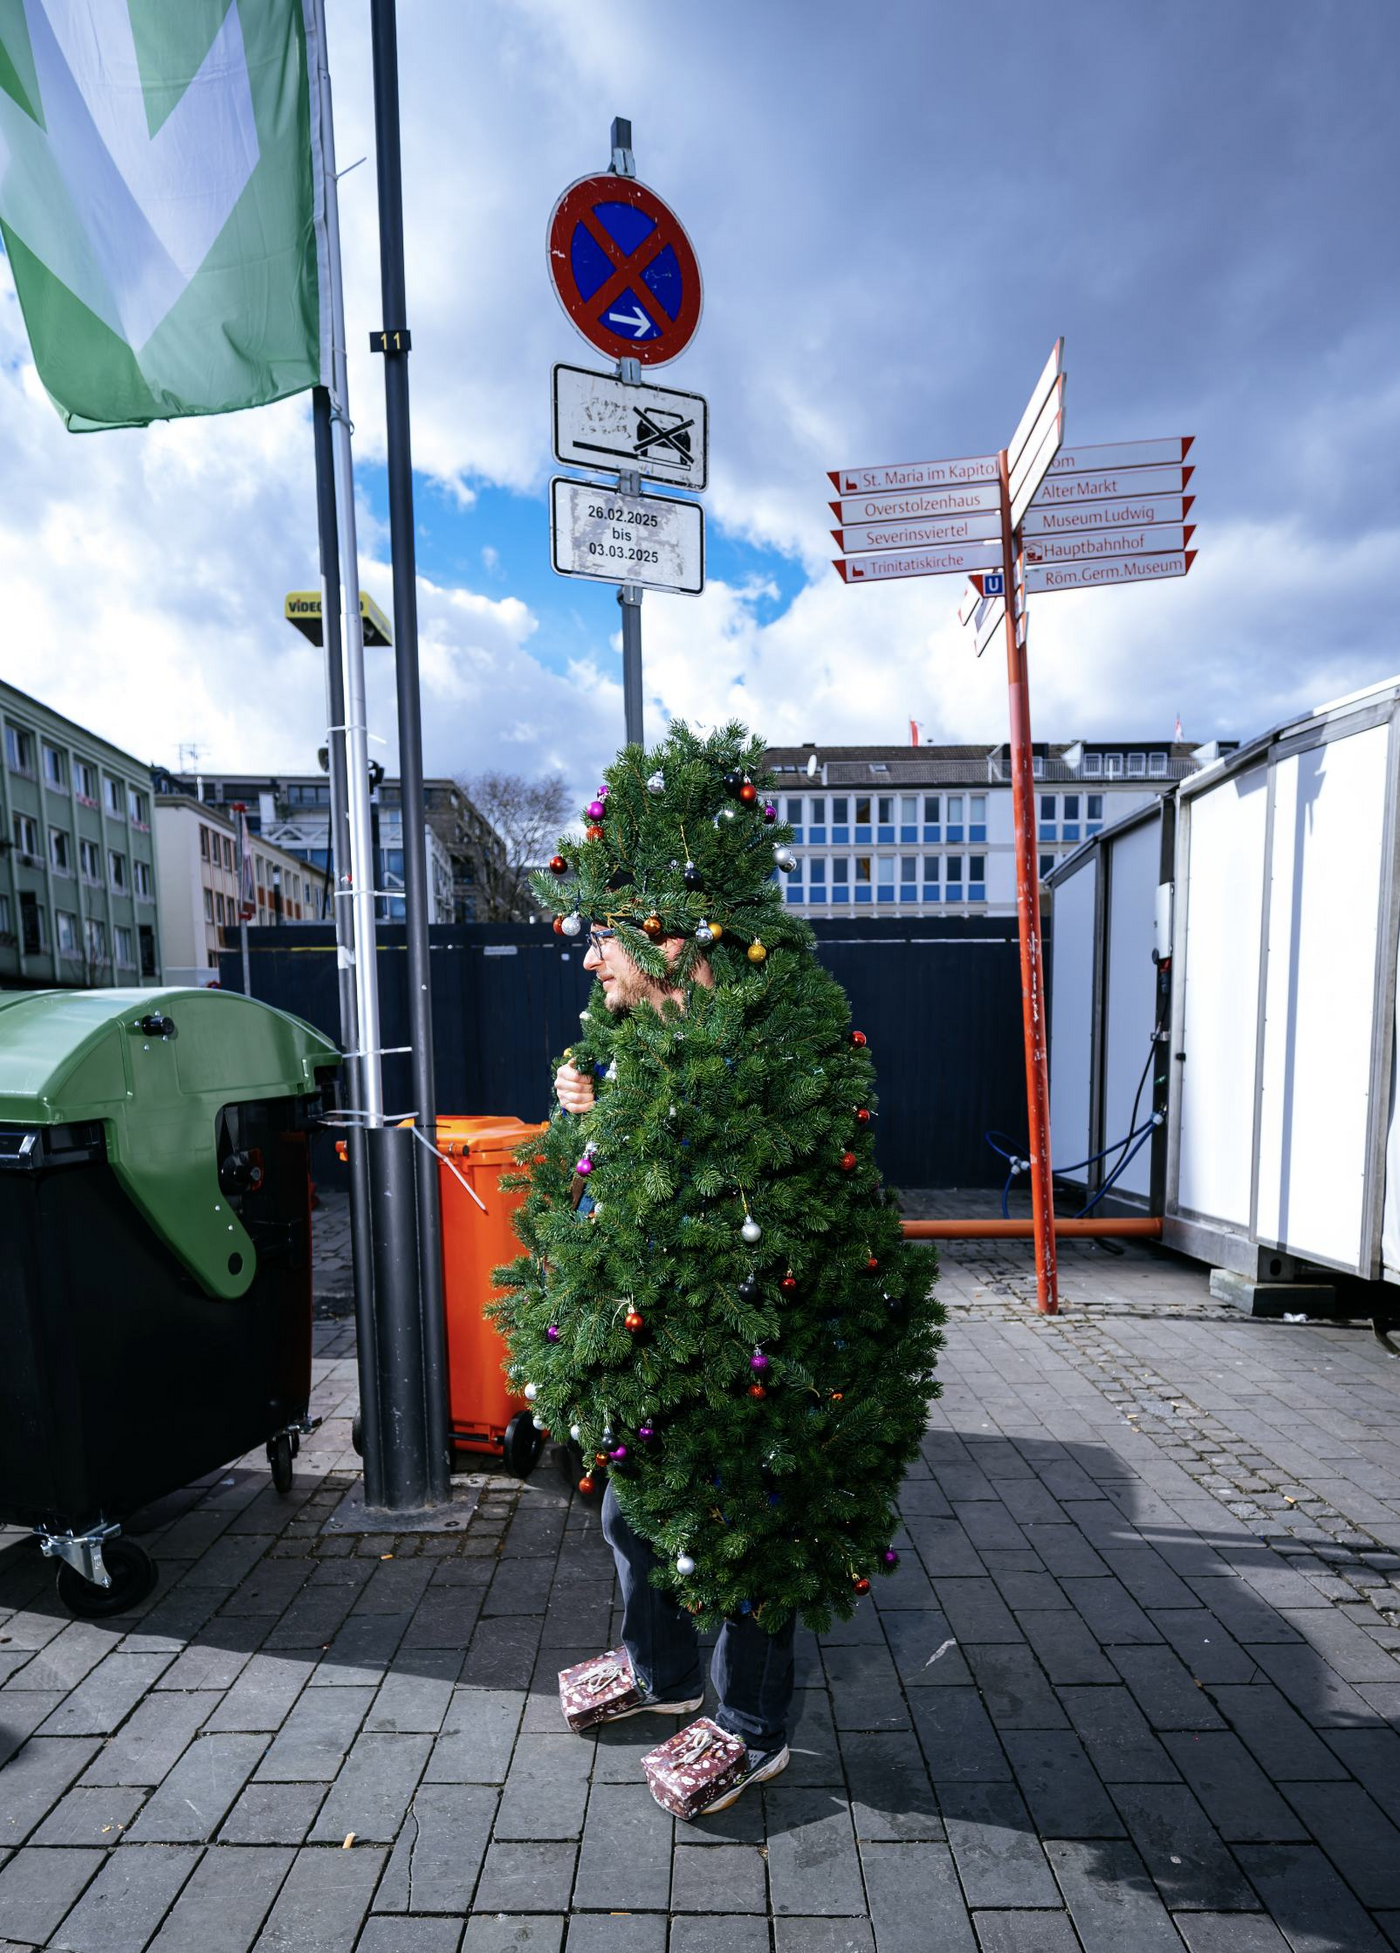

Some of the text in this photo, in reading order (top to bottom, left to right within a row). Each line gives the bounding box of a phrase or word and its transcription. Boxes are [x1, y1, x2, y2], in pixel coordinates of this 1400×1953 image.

[380, 332, 401, 350] 11
[1051, 456, 1075, 469] om
[863, 460, 999, 487] St. Maria im Kapitol
[1041, 479, 1118, 499] Alter Markt
[588, 505, 658, 527] 26.02.2025
[864, 494, 981, 517] Overstolzenhaus
[1042, 505, 1155, 528] Museum Ludwig
[612, 527, 632, 542] bis
[866, 522, 969, 546] Severinsviertel
[589, 542, 659, 563] 03.03.2025
[1044, 533, 1146, 558] Hauptbahnhof
[870, 554, 964, 575] Trinitatiskirche
[989, 578, 999, 591] U
